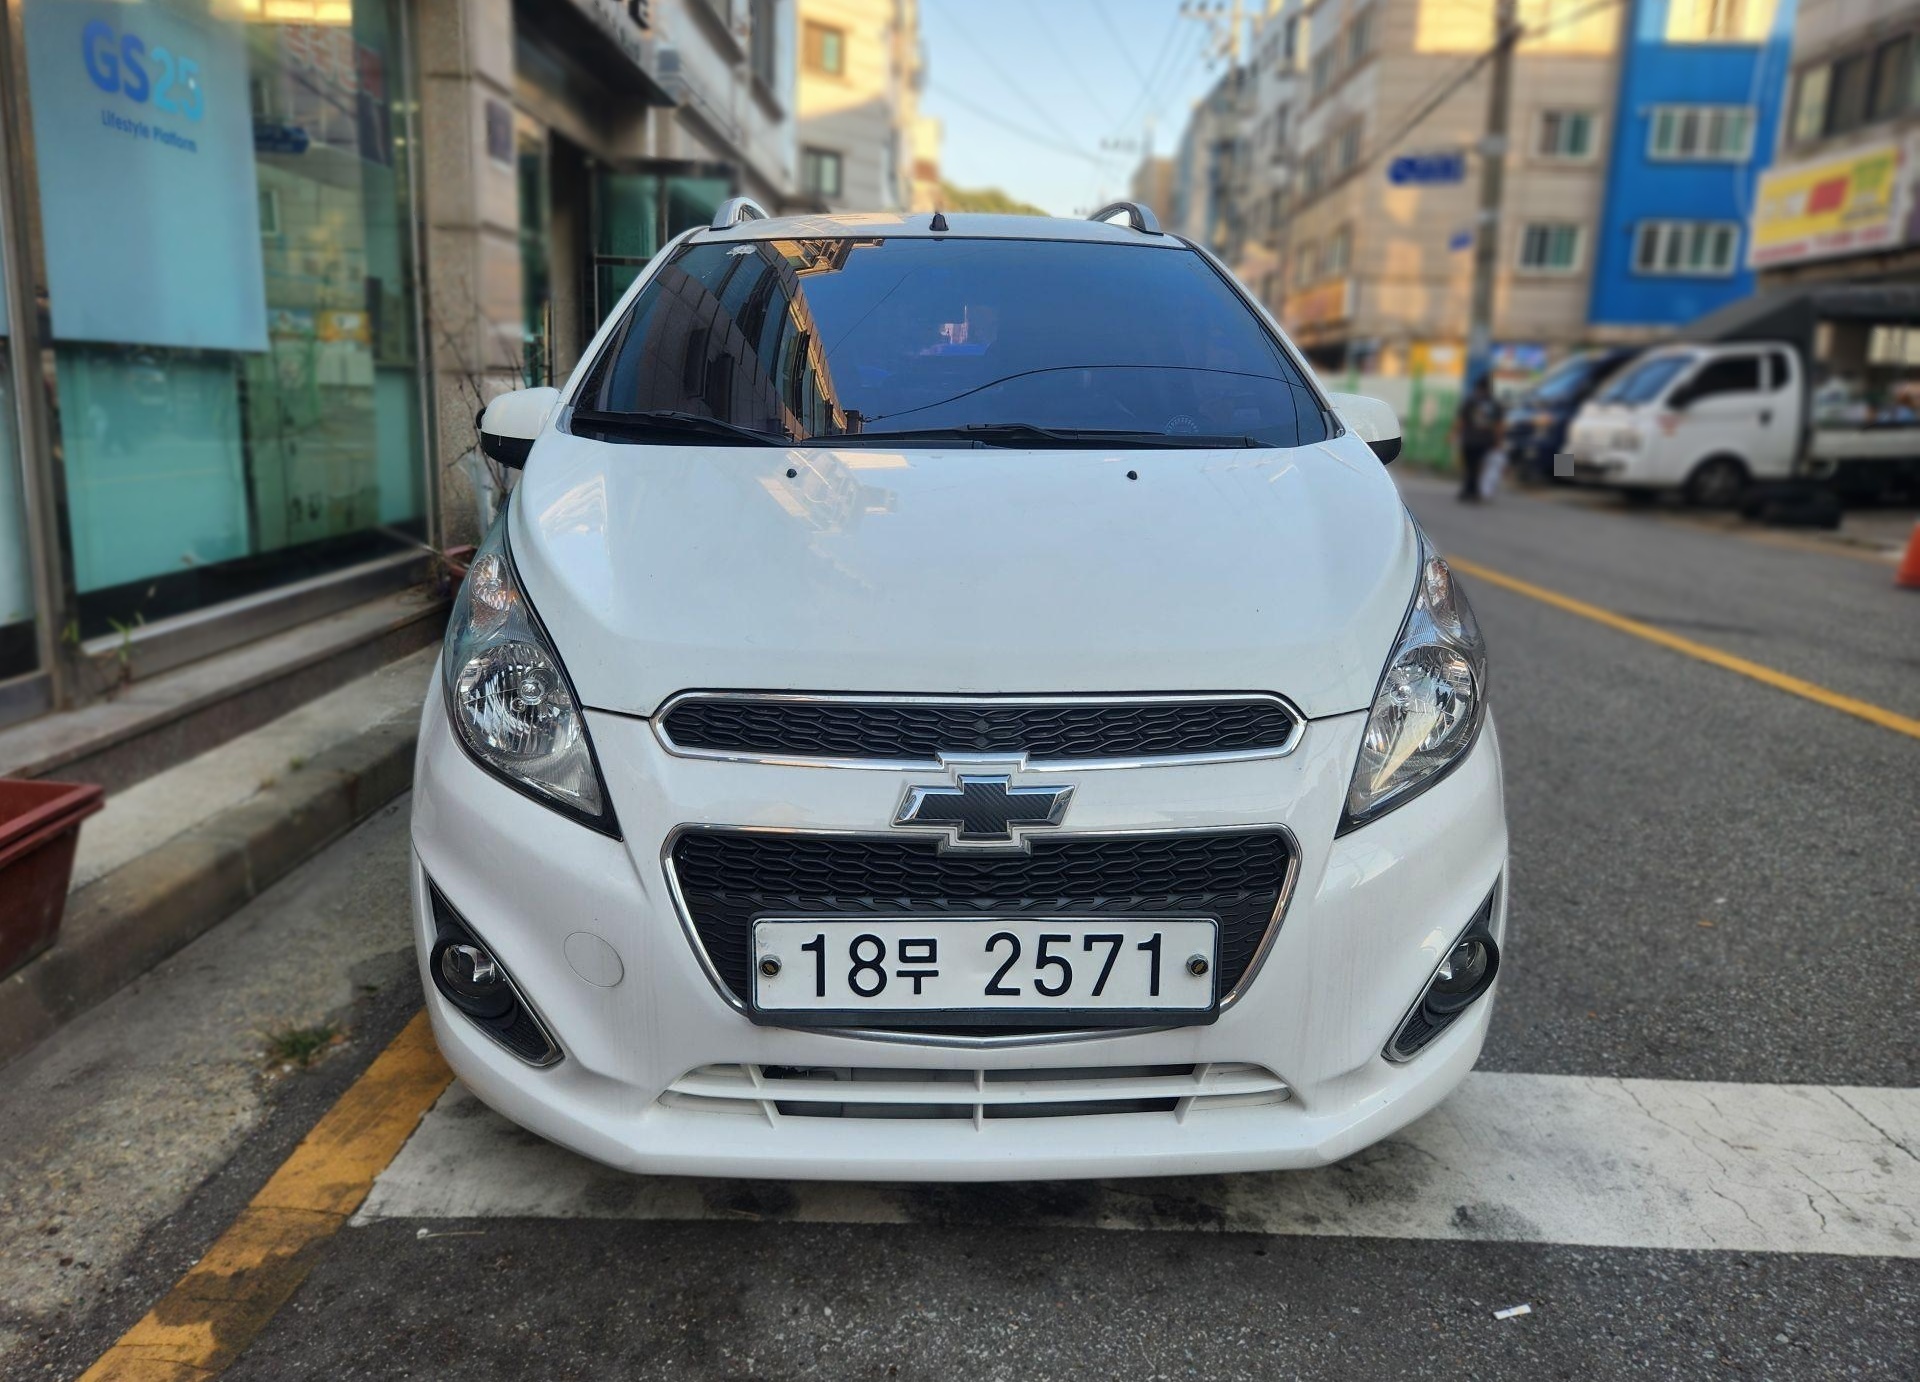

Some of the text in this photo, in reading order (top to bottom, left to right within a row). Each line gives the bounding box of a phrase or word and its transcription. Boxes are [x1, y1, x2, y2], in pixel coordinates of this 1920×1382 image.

[82, 20, 204, 121] GS25
[102, 110, 197, 153] Lifestyle Platform
[801, 932, 1162, 998] 18무 2571
